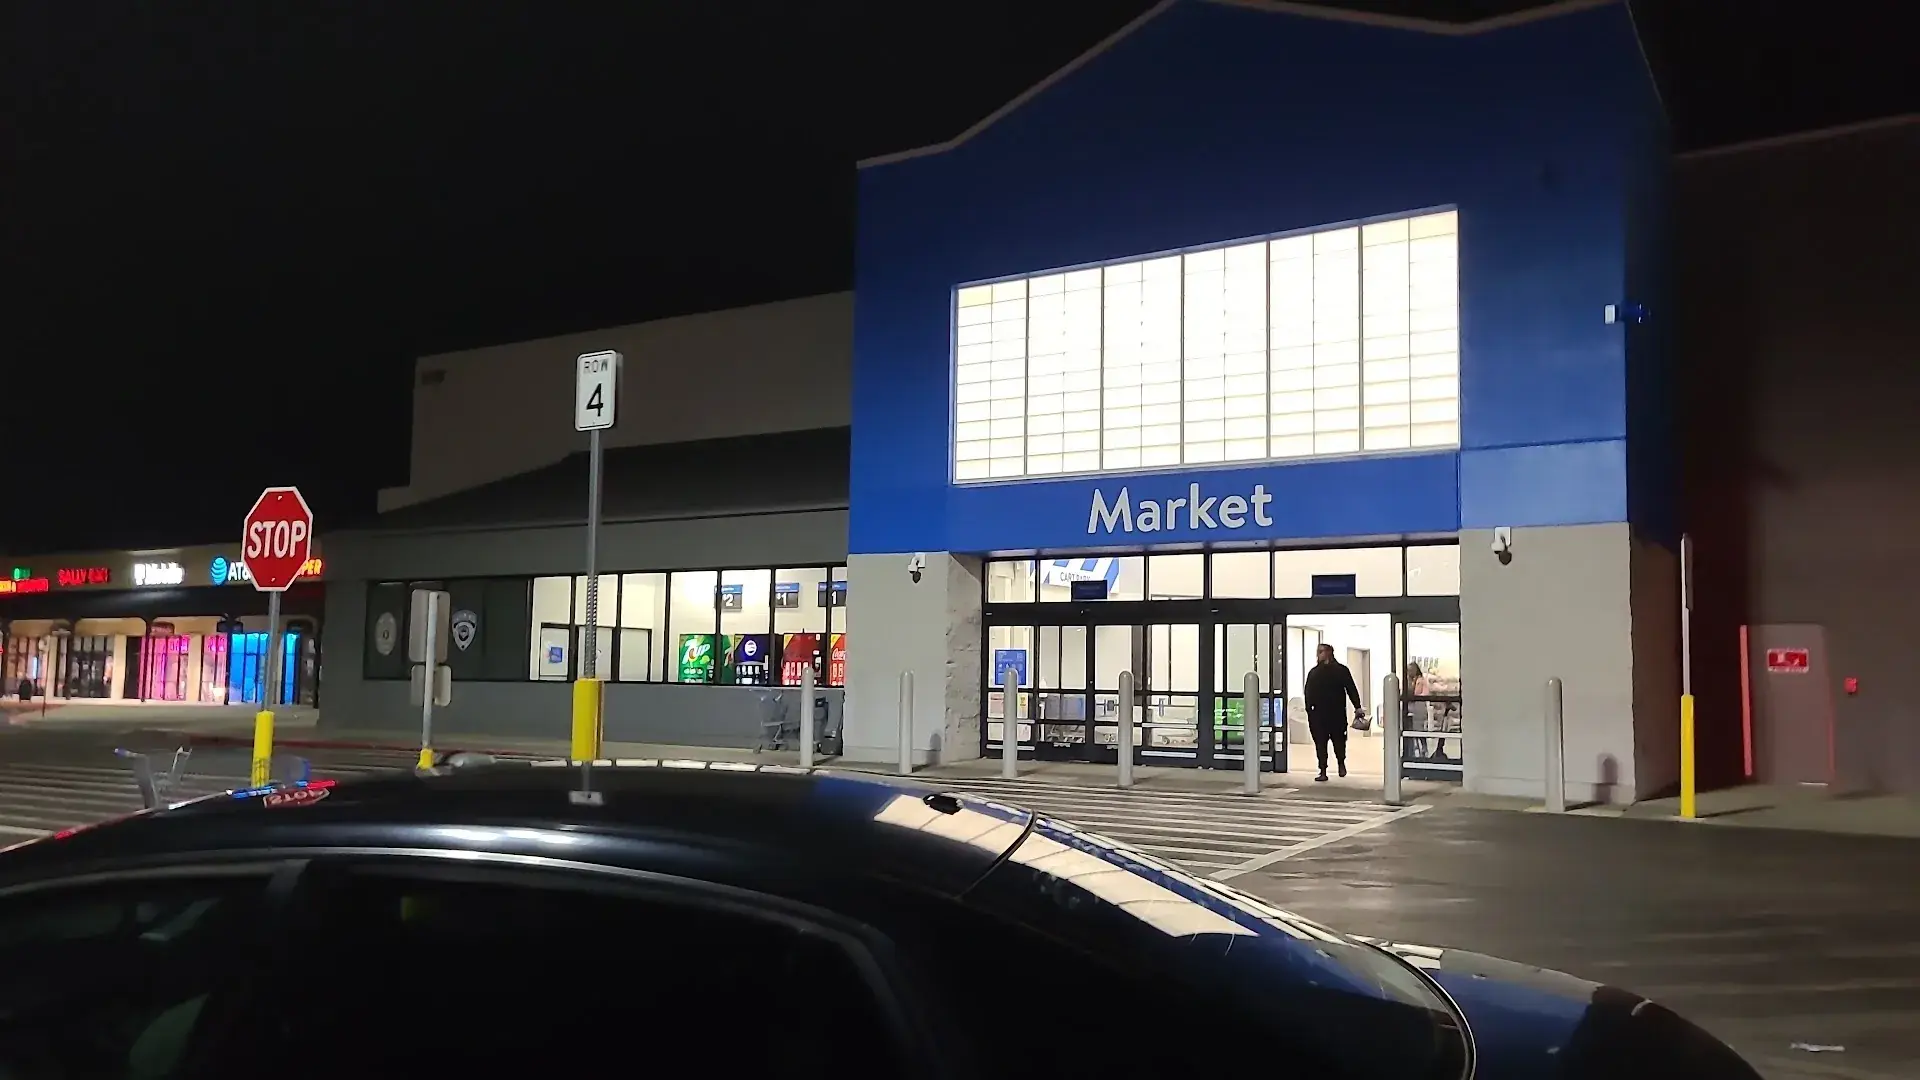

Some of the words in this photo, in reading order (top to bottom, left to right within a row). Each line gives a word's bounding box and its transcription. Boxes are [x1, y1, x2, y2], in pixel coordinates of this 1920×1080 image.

[583, 359, 608, 373] ROW
[586, 383, 604, 417] 4
[1087, 482, 1273, 534] Market
[247, 520, 307, 559] STOP
